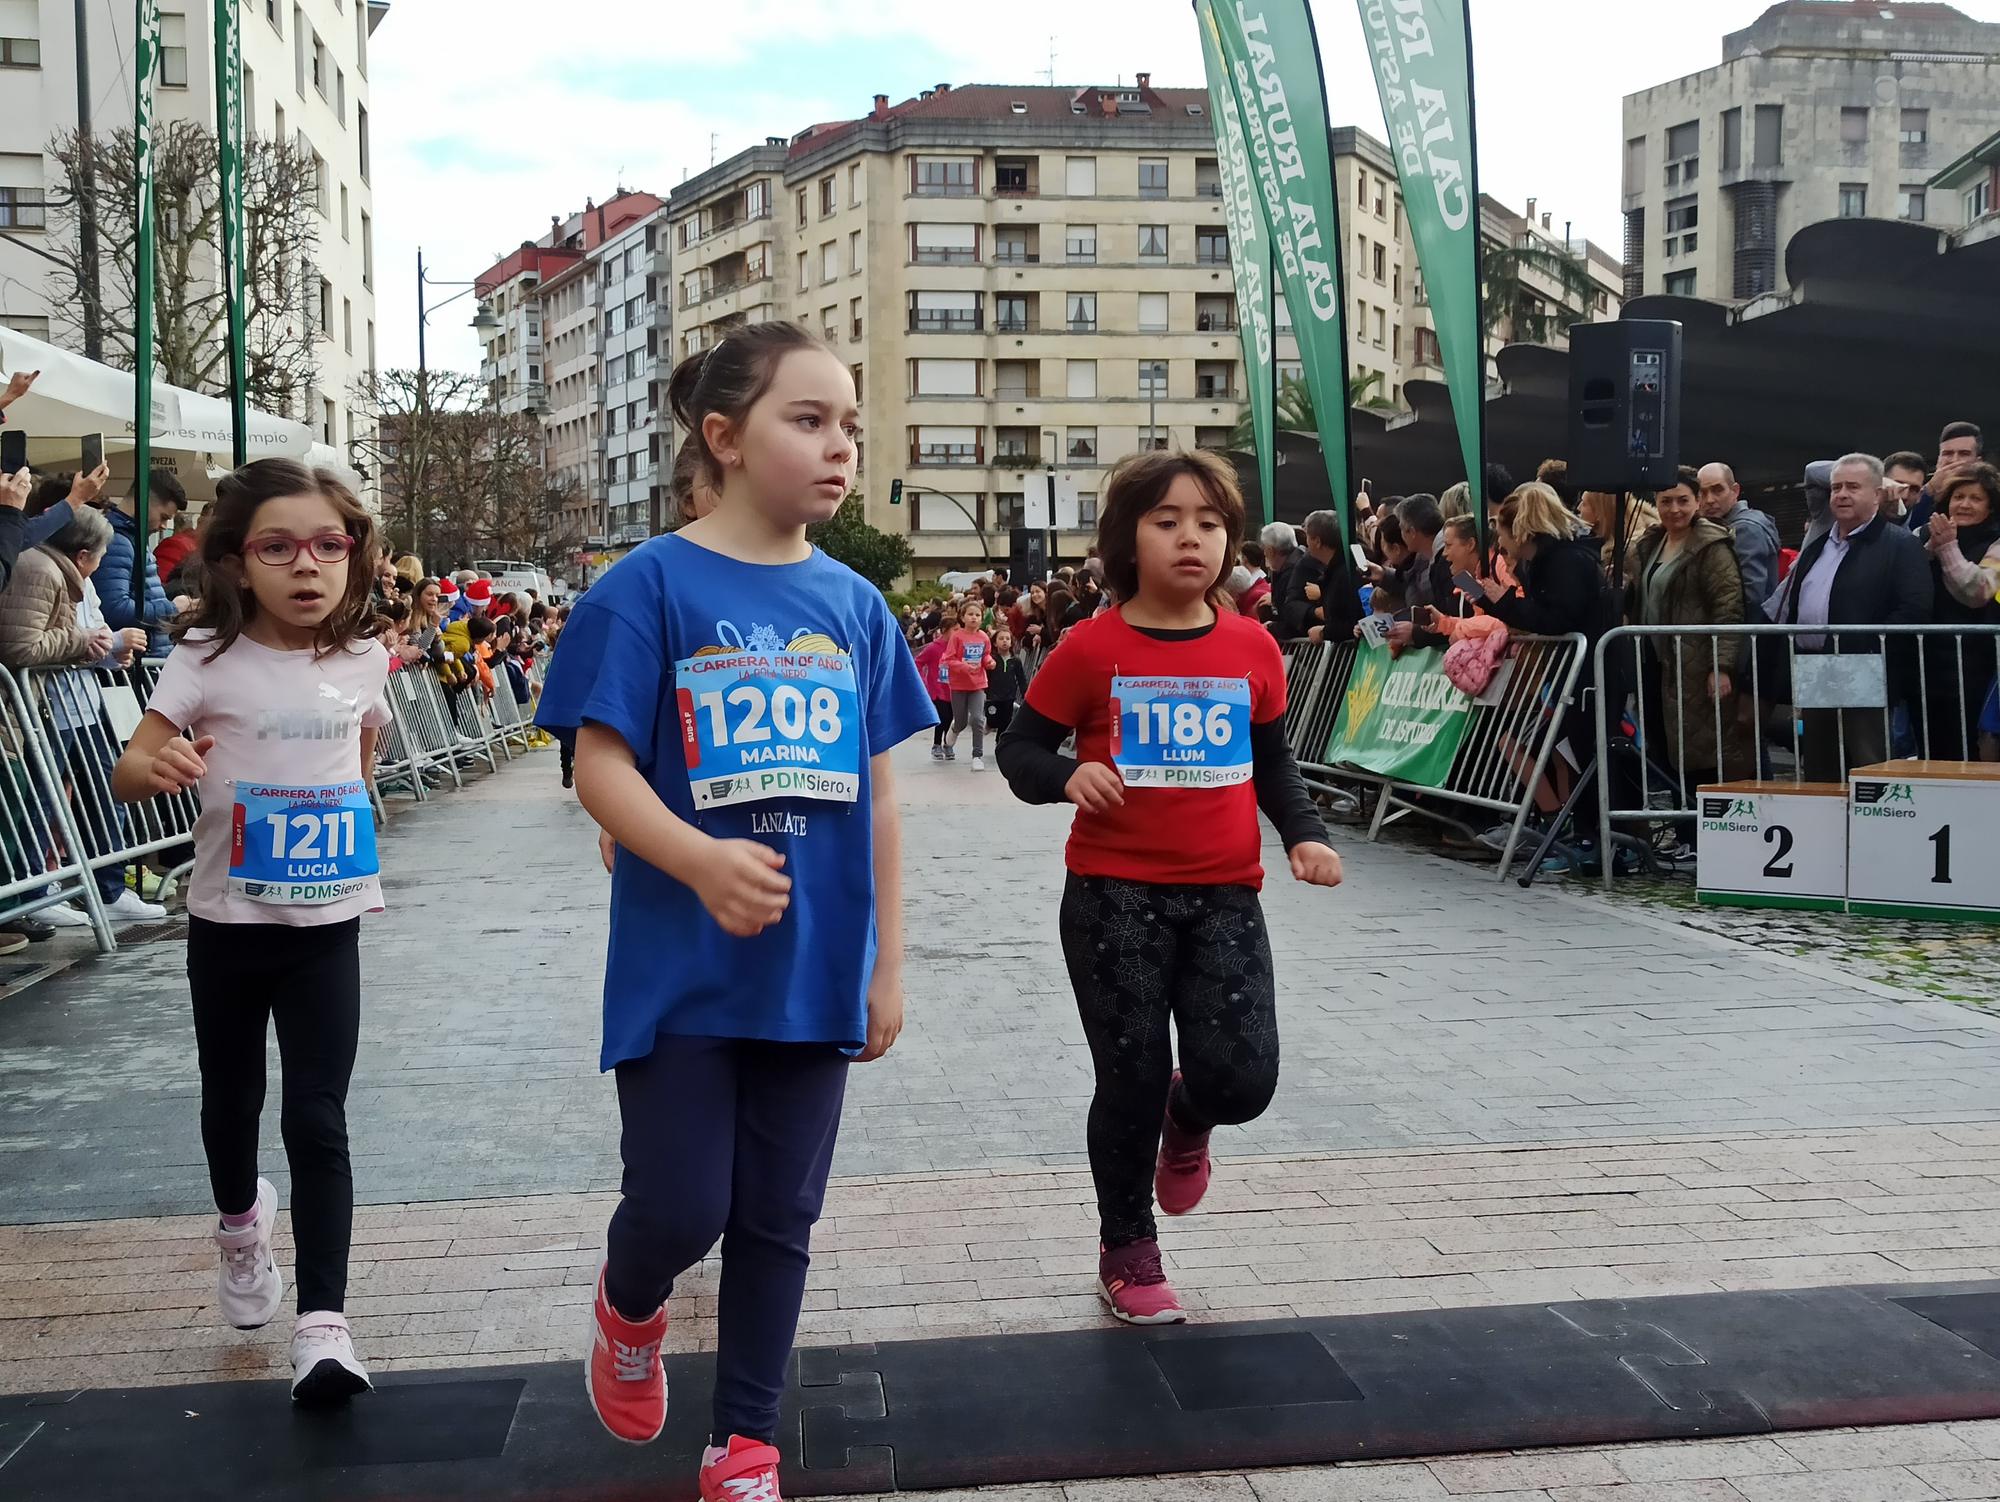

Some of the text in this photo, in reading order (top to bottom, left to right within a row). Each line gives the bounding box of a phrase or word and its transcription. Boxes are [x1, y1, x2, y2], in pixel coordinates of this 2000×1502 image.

[691, 656, 770, 674] CARRERA
[774, 656, 795, 667] FIN
[817, 655, 843, 671] AÑO
[1124, 681, 1180, 690] CARRERA
[1183, 681, 1200, 690] FIN
[700, 685, 842, 747] 1208
[1131, 703, 1233, 747] 1186
[741, 745, 820, 765] MARINA
[1162, 749, 1206, 762] LLUM
[761, 772, 844, 794] PDMSiero
[1165, 769, 1240, 783] PDMSiero
[250, 786, 316, 799] CARRERA
[320, 788, 336, 799] FIN
[337, 785, 349, 797] DE
[1854, 806, 1917, 819] PDMSiero
[752, 811, 807, 837] LANZATE
[1702, 821, 1759, 833] PDMSiero
[267, 810, 356, 860] 1211
[1763, 824, 1794, 878] 2
[1928, 824, 1952, 884] 1
[287, 863, 339, 877] LUCIA
[290, 882, 363, 900] PDMSiero
